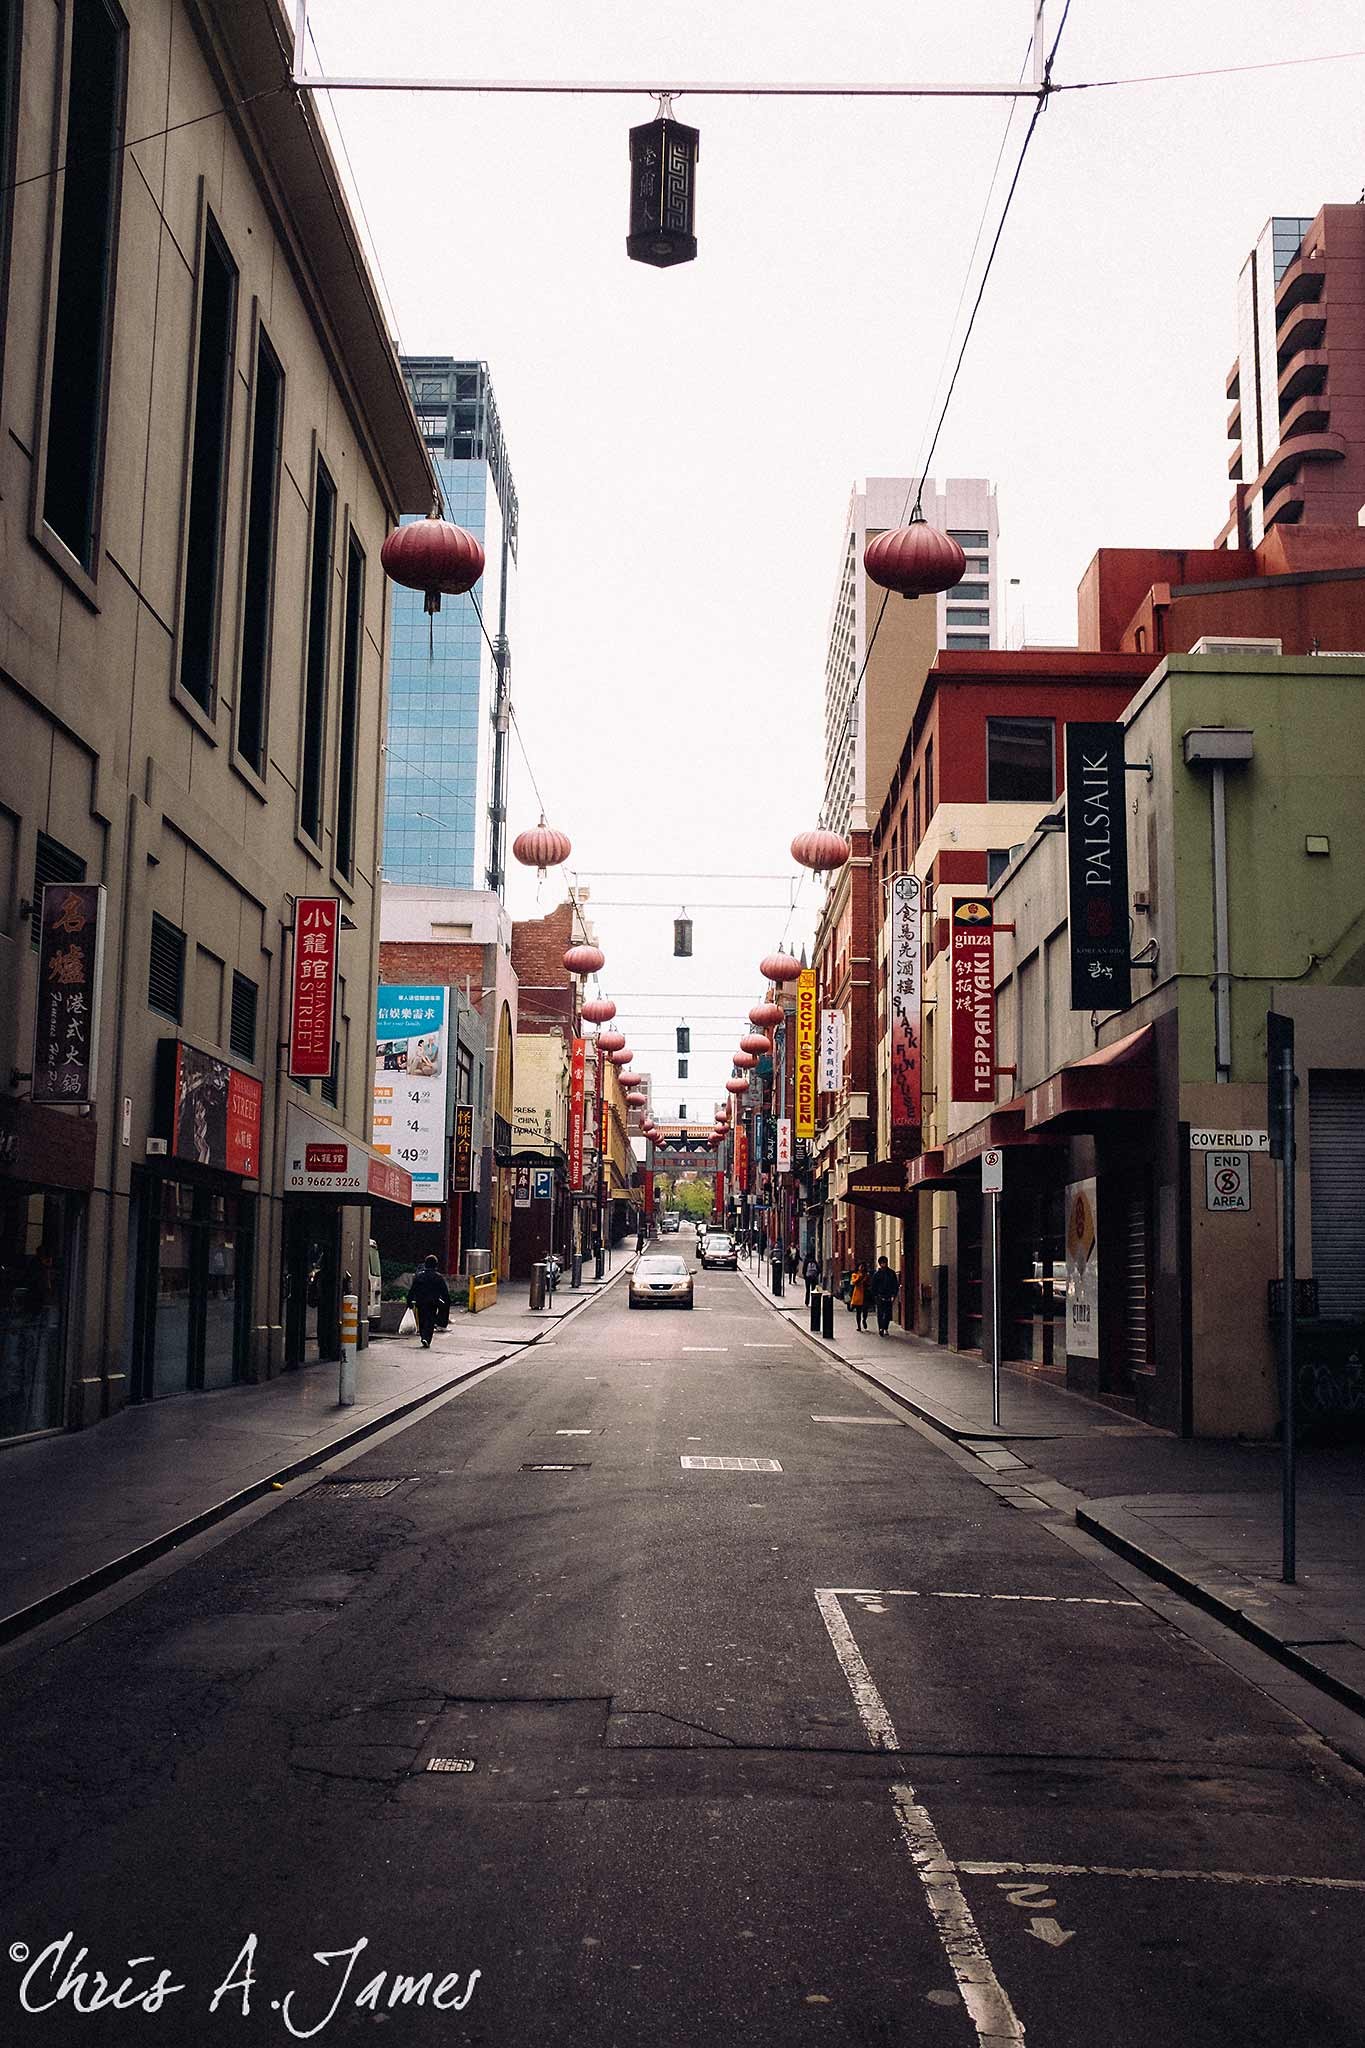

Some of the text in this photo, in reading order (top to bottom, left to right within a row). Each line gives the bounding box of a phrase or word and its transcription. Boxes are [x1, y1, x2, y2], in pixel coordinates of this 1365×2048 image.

[1082, 751, 1112, 887] PALSAIK
[955, 932, 992, 948] ginza
[297, 982, 314, 1054] STREET
[313, 982, 326, 1053] SHANGHAI
[893, 996, 918, 1048] SHARK
[974, 952, 992, 1092] TEPPANYAKI
[232, 1094, 258, 1121] STREET
[800, 1064, 812, 1124] GARDEN
[1192, 1133, 1270, 1146] COVERLID P
[1214, 1156, 1241, 1167] END
[291, 1176, 360, 1187] 03 9662 3226
[537, 1173, 548, 1186] P
[1213, 1196, 1245, 1207] AREA
